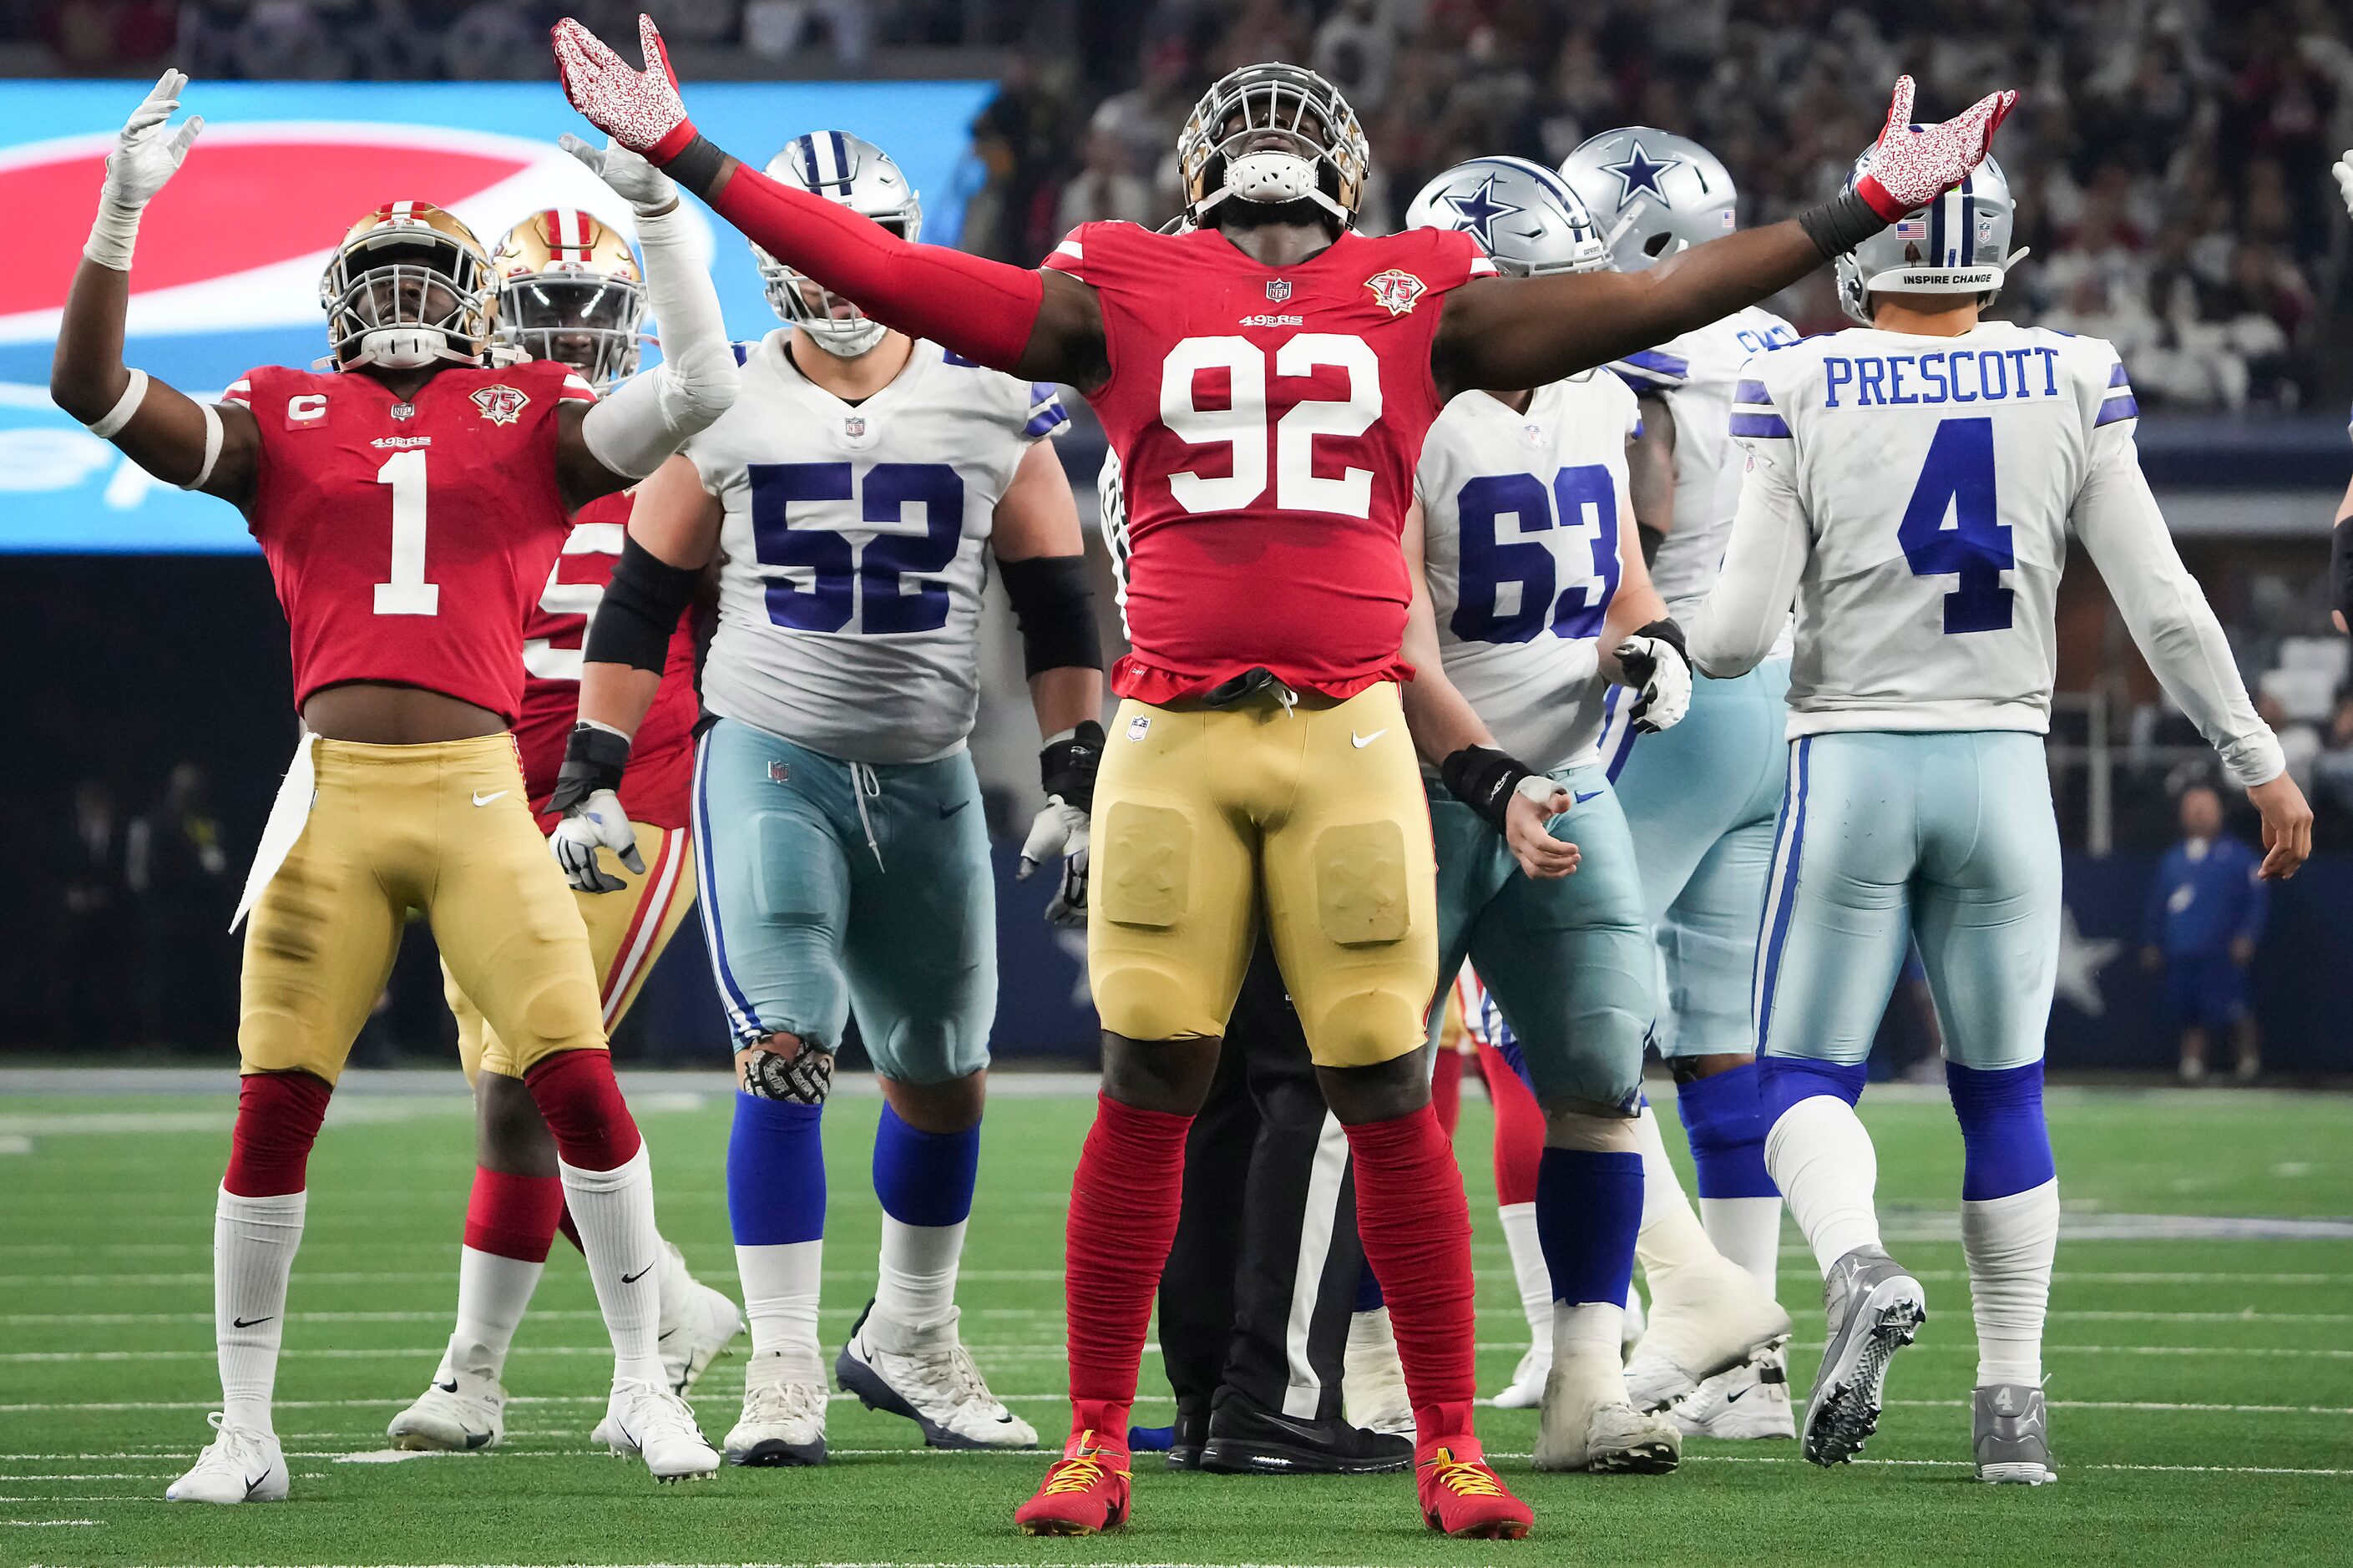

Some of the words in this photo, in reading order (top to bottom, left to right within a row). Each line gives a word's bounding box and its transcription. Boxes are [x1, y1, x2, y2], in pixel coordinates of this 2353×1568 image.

[1378, 278, 1413, 301] 75
[1903, 276, 1949, 285] INSPIRE
[1952, 274, 1991, 284] CHANGE
[1270, 288, 1290, 299] NFL
[1238, 315, 1303, 327] 49ERS
[1824, 348, 2059, 407] PRESCOTT
[288, 394, 327, 420] C
[394, 406, 412, 416] NFL
[483, 392, 514, 412] 75
[1160, 332, 1383, 519] 92
[370, 437, 432, 448] 49ERS
[373, 448, 439, 616] 1
[1897, 417, 2015, 634] 4
[747, 463, 964, 634] 52
[1450, 464, 1622, 644] 63
[1995, 1387, 2013, 1410] 4
